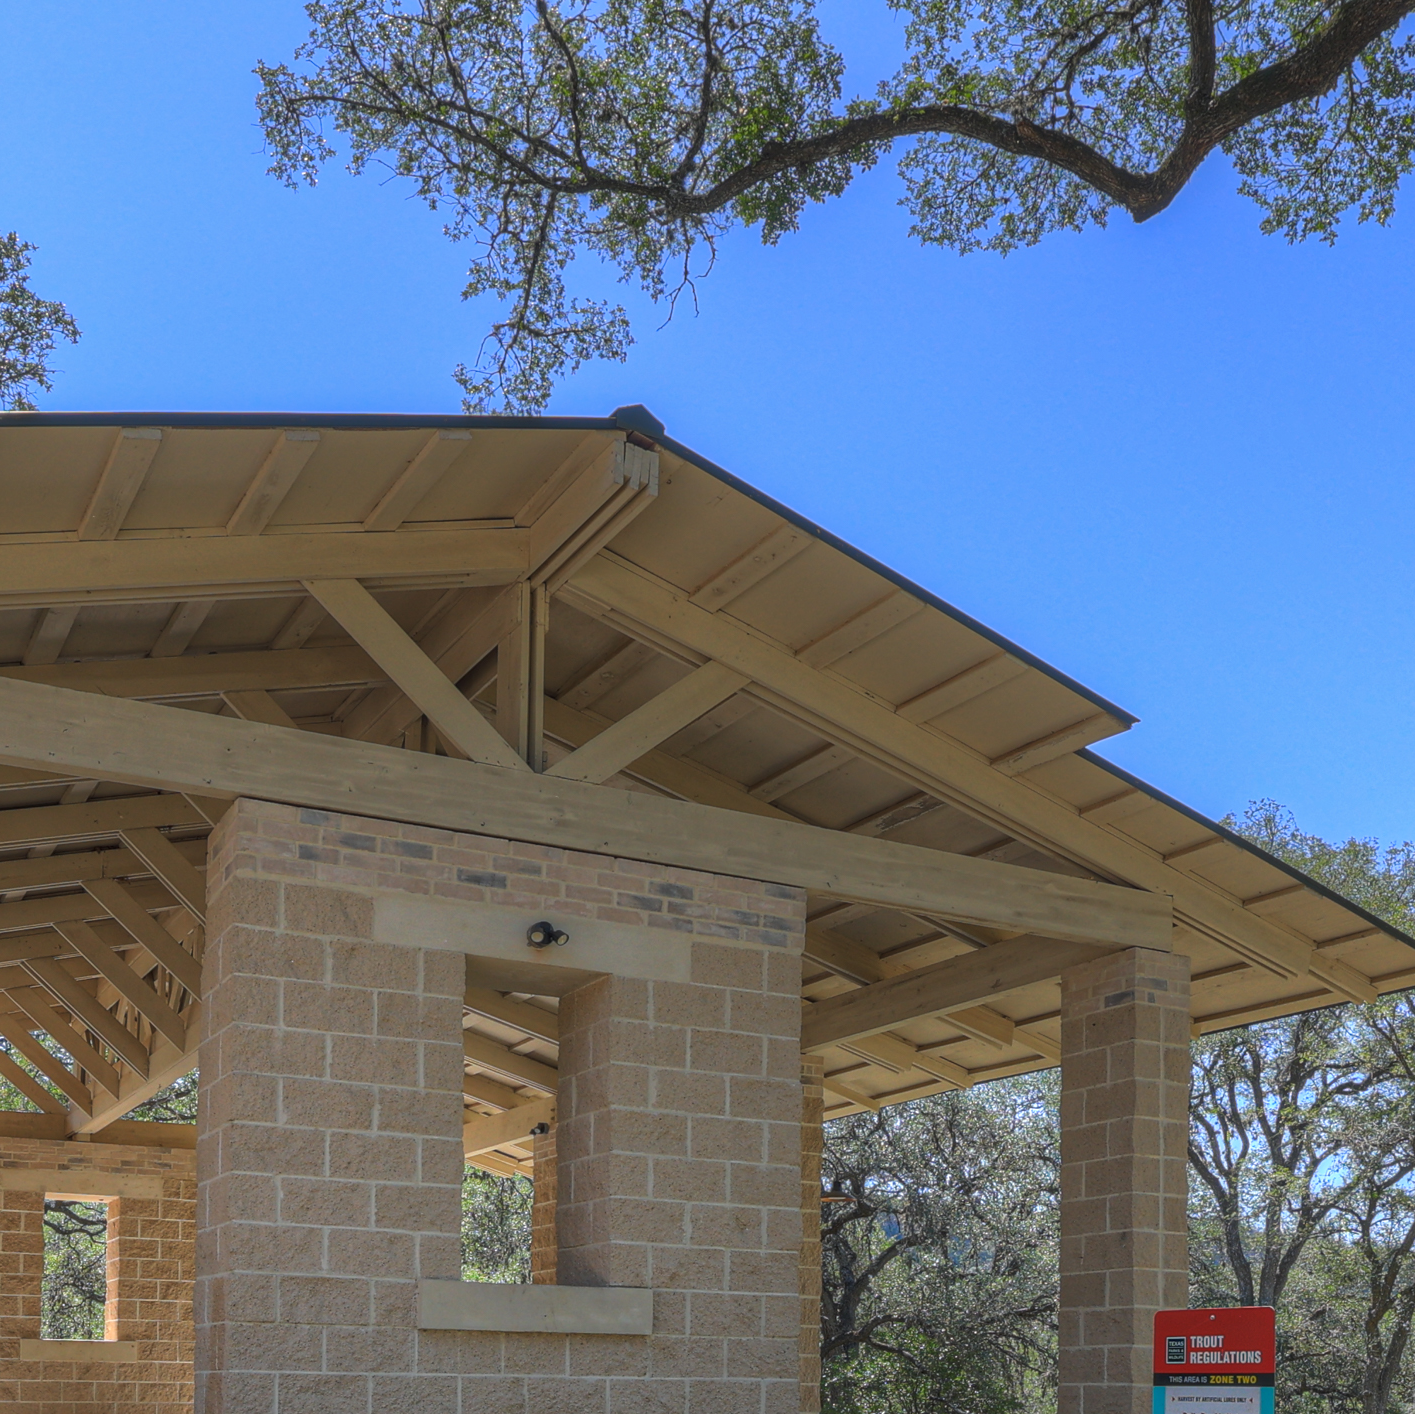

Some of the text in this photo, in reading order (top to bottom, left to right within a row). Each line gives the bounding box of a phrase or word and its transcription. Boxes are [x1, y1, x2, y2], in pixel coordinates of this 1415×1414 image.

[1190, 1336, 1224, 1348] TROUT
[1190, 1351, 1261, 1364] REGULATIONS
[1210, 1375, 1234, 1384] ZONE
[1236, 1375, 1257, 1384] TWO
